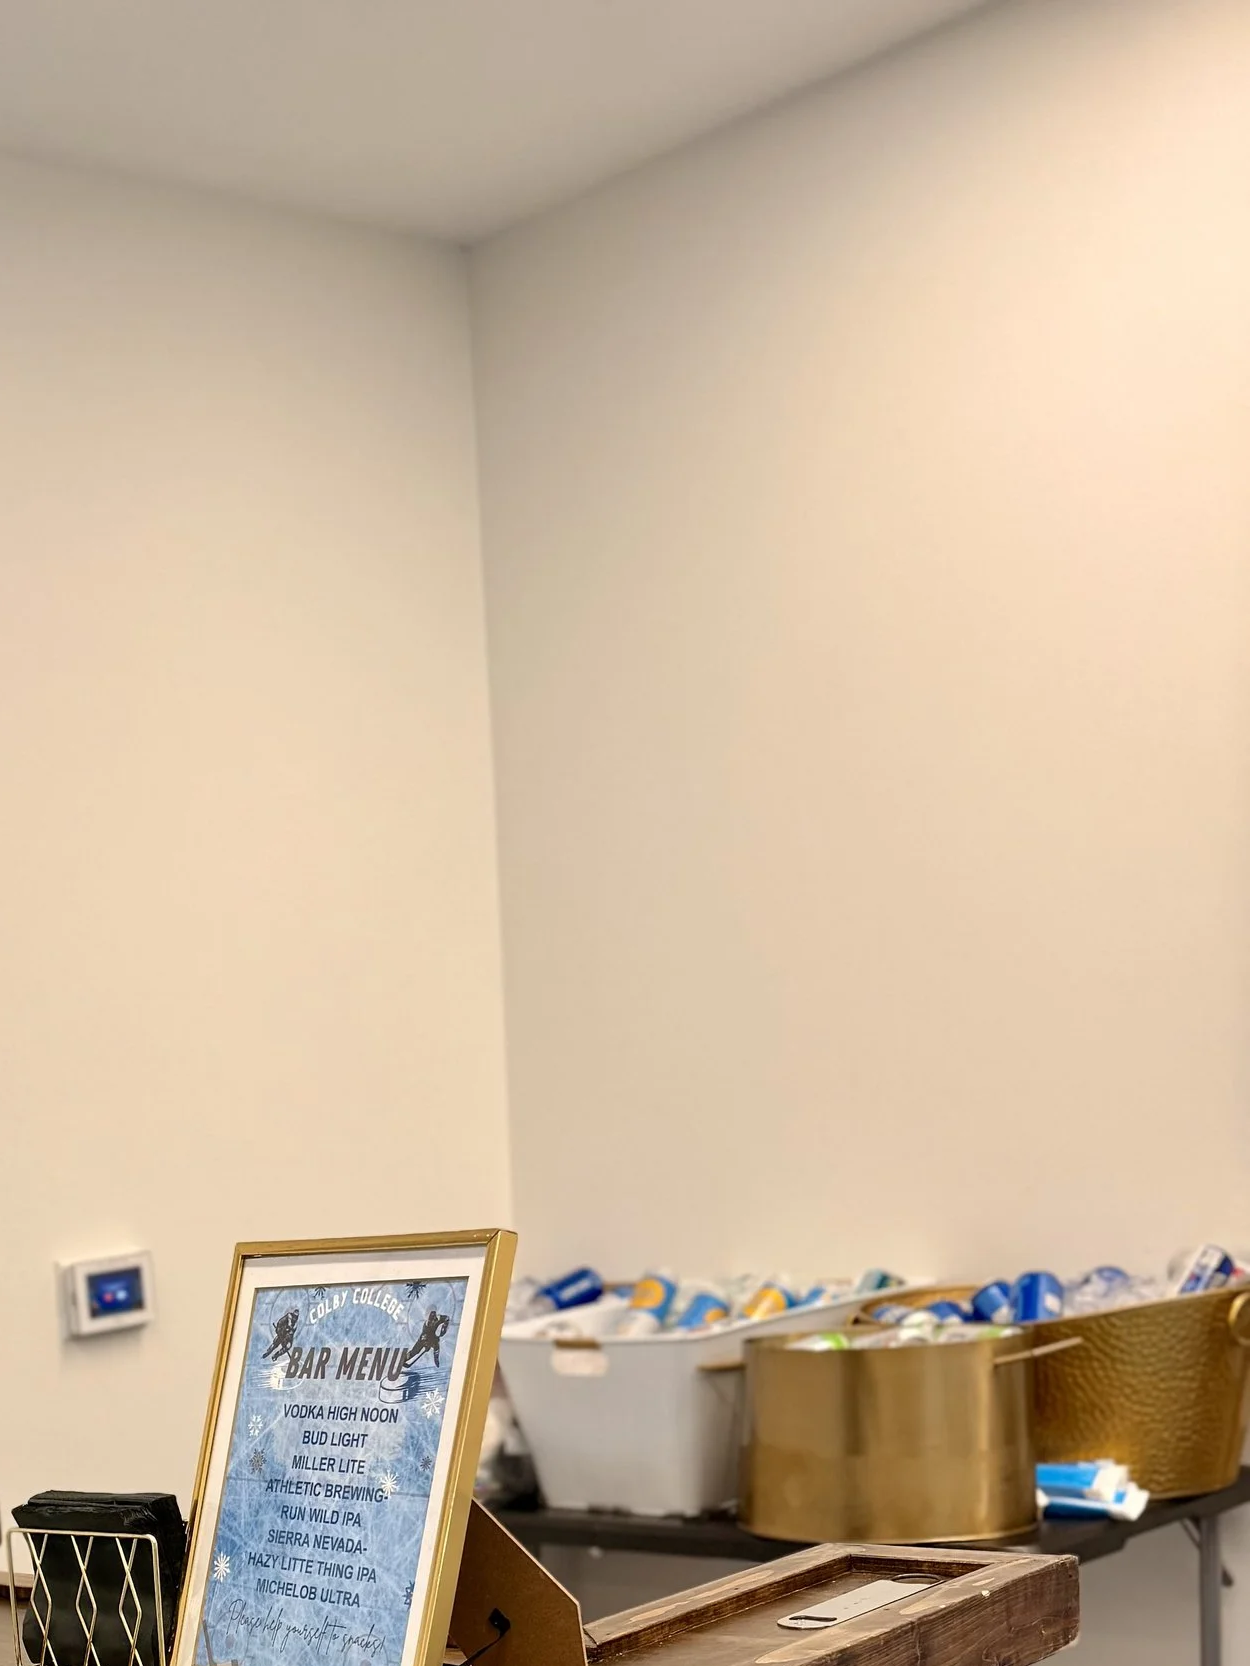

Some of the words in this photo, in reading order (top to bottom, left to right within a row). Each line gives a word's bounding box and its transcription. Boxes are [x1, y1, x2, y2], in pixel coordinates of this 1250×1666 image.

[309, 1290, 348, 1324] COLBY
[352, 1287, 405, 1321] COLLEGE
[286, 1347, 331, 1380] BAR
[335, 1346, 410, 1382] MENU
[283, 1403, 325, 1420] VODKA
[327, 1405, 358, 1421] HIGH
[360, 1406, 399, 1424] NOON
[302, 1430, 328, 1445] BUD
[330, 1431, 368, 1449] LIGHT
[291, 1454, 336, 1472] MILLER
[338, 1457, 366, 1475] LITE
[265, 1478, 322, 1498] ATHLETIC
[280, 1504, 307, 1521] RUN
[309, 1507, 340, 1525] WILD
[342, 1511, 362, 1528] IPA
[267, 1528, 310, 1548] SIERRA
[312, 1533, 368, 1555] NEVADA-
[247, 1551, 280, 1569] HAZY
[280, 1556, 314, 1575] LITTE
[317, 1560, 354, 1580] THING
[356, 1565, 377, 1584] IPA
[256, 1577, 318, 1601] MICHELOB
[320, 1587, 361, 1609] ULTRA
[226, 1598, 261, 1635] Please
[263, 1606, 284, 1648] help
[280, 1615, 329, 1656] yourself
